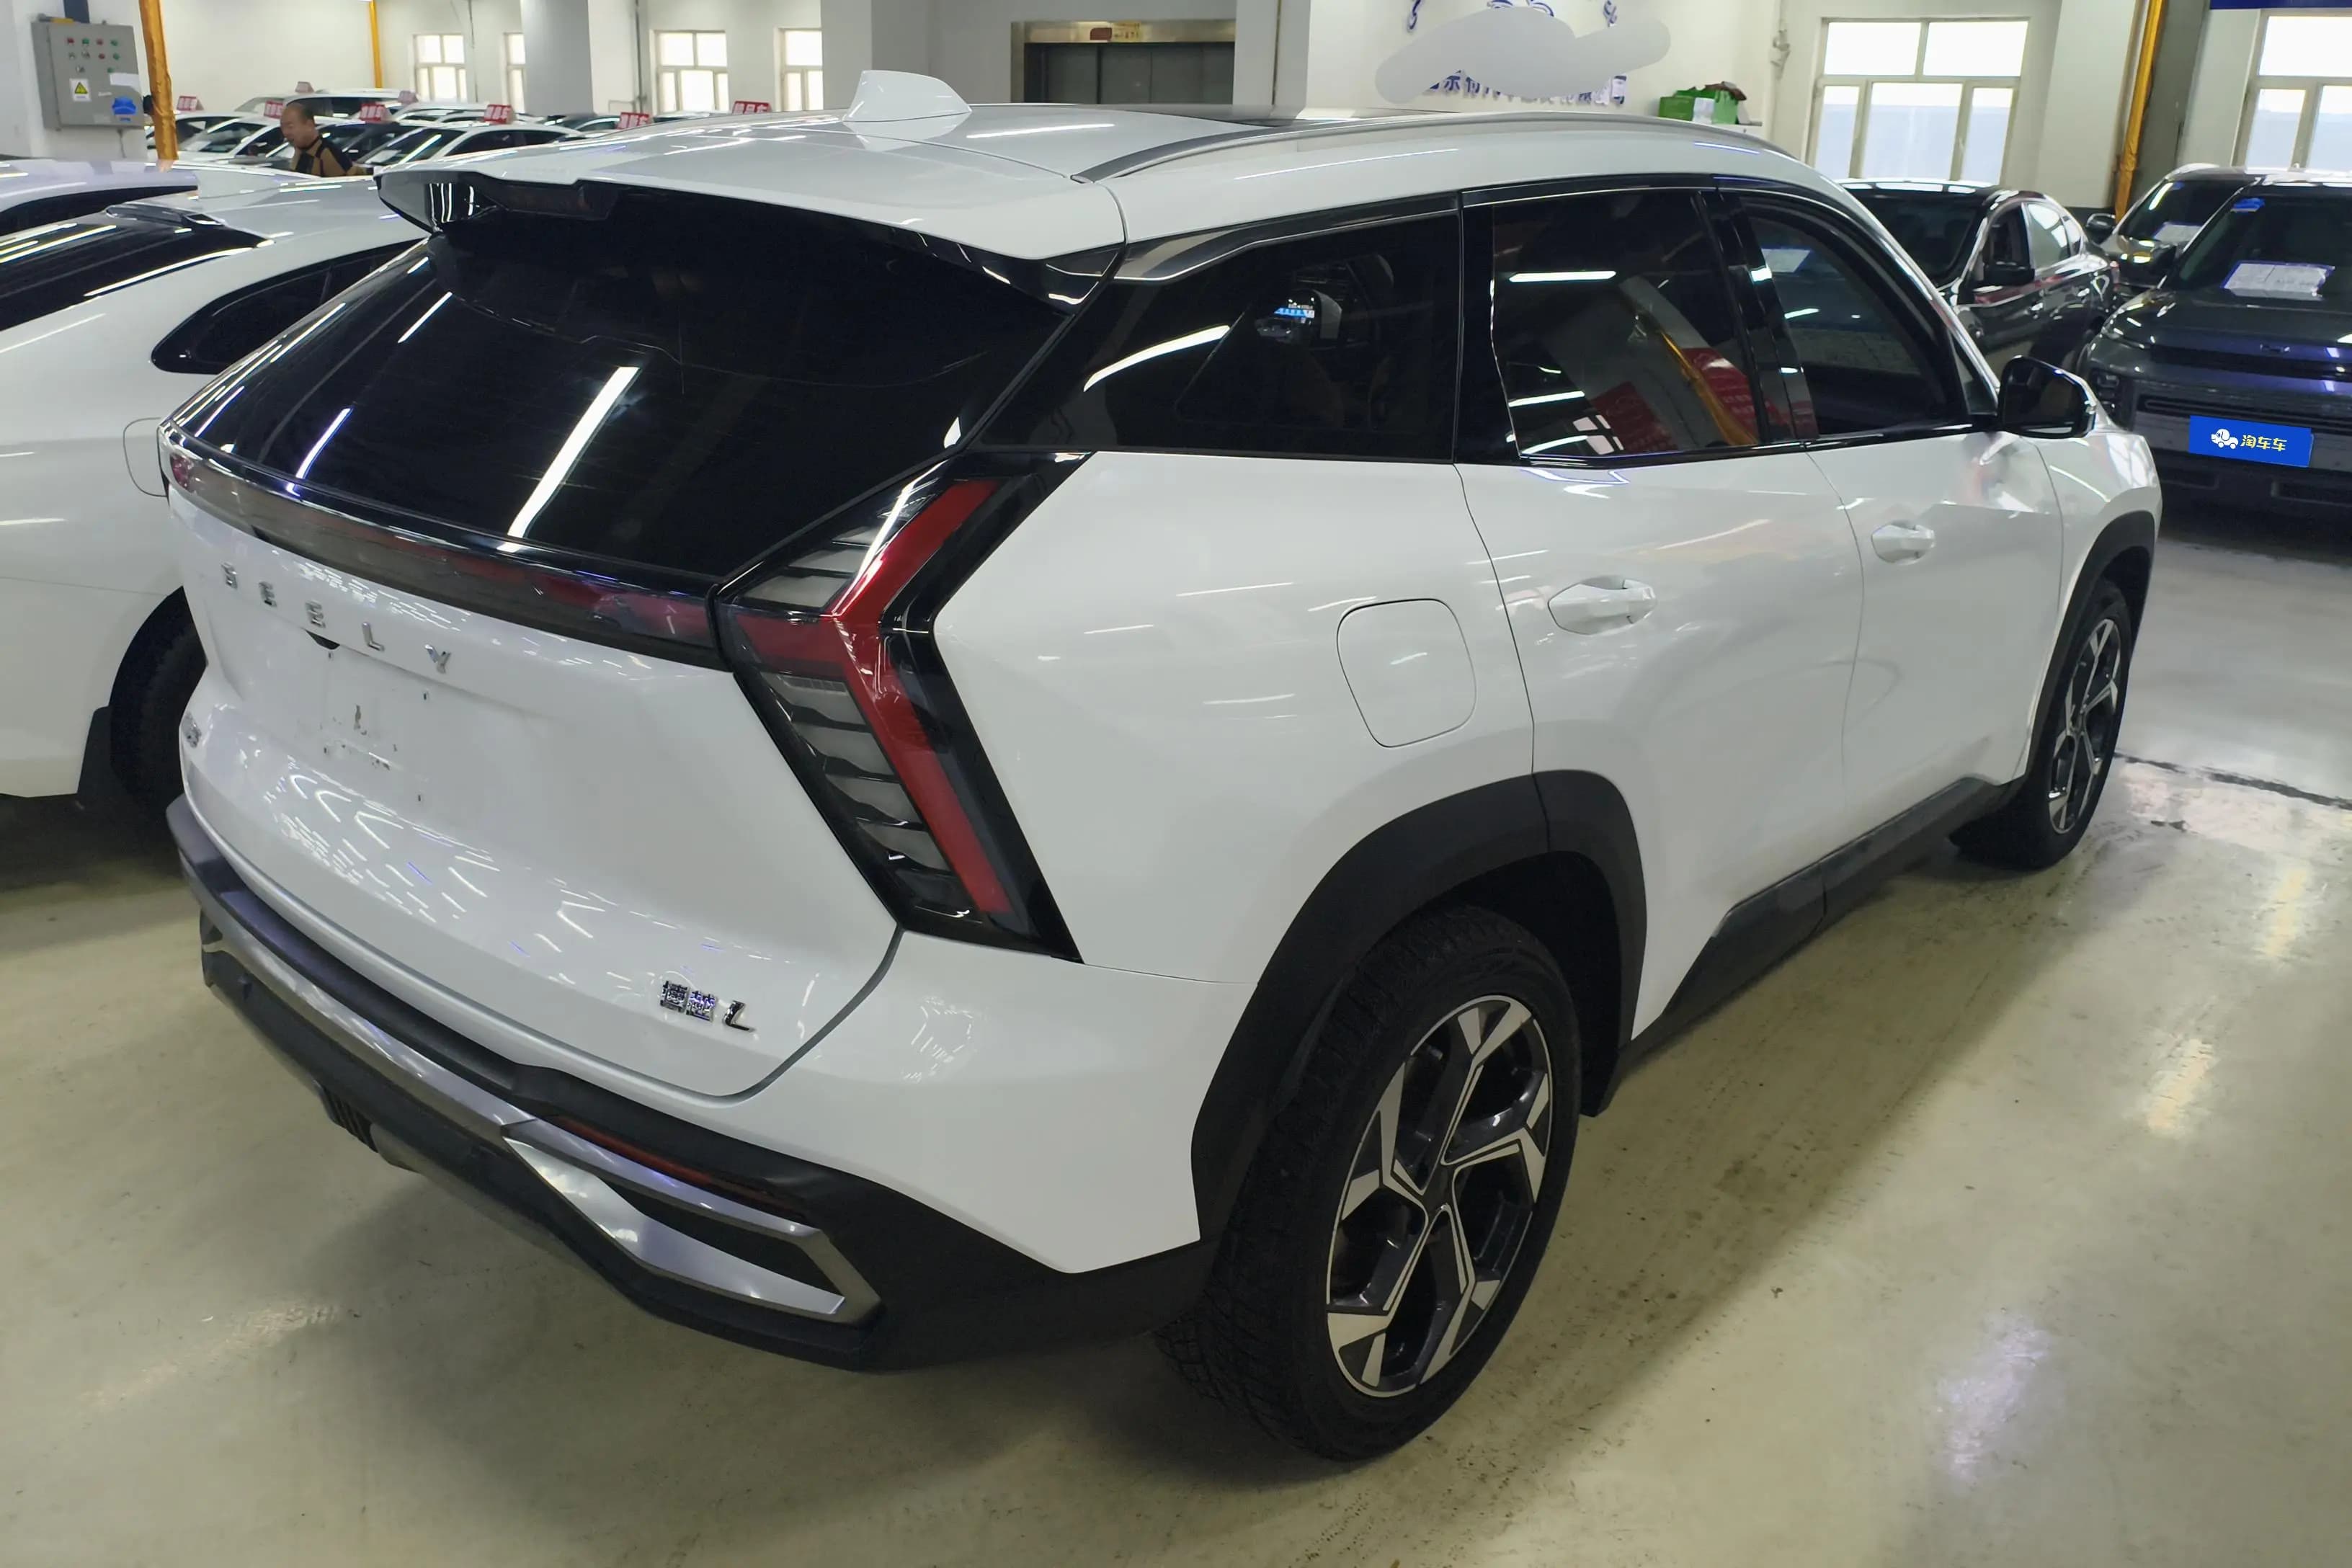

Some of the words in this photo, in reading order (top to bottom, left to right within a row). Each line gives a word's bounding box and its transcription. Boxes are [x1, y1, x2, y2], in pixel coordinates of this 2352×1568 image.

[2240, 435, 2288, 452] 淘车车
[220, 561, 452, 674] GEELY
